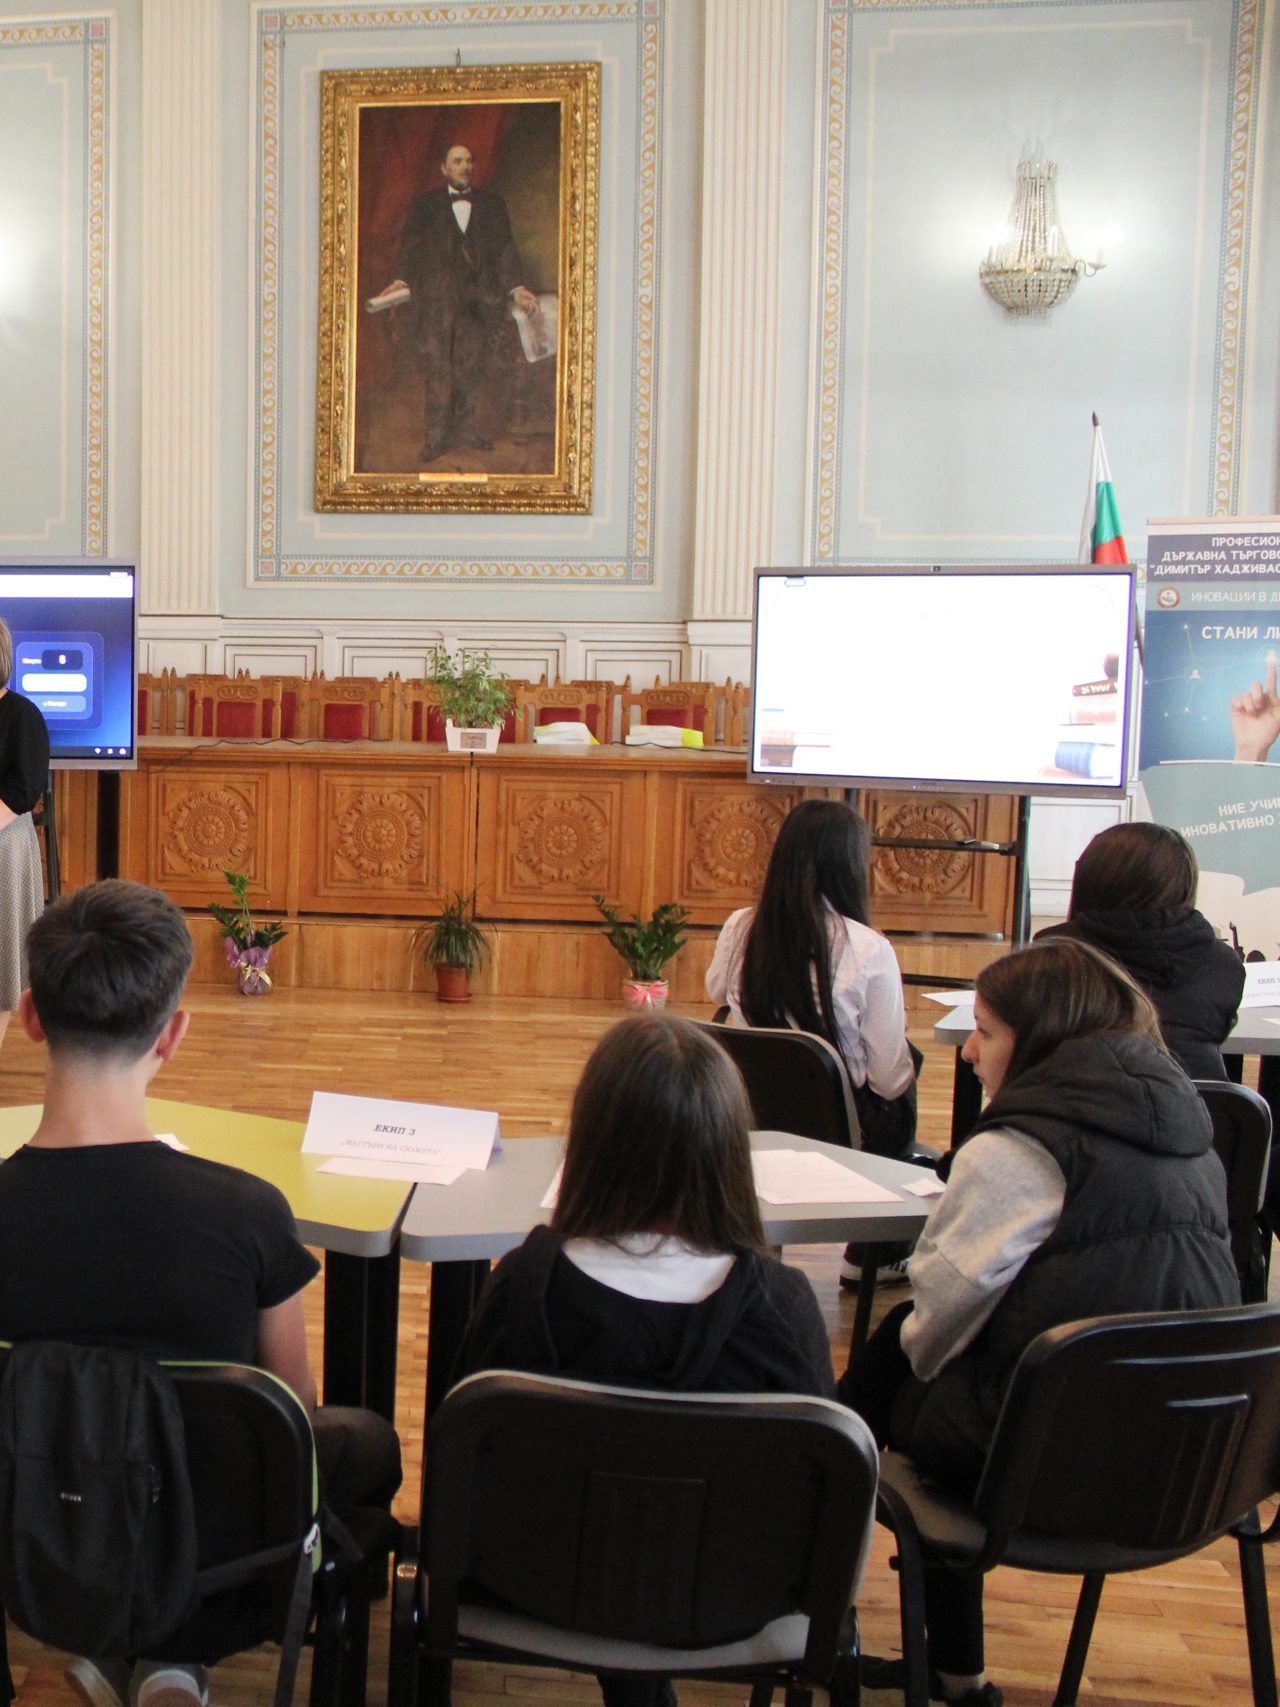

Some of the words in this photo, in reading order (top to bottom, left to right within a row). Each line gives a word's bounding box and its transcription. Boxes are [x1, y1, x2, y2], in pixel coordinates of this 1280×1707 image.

[1161, 550, 1227, 562] ДЪРЖАВНА
[1191, 591, 1256, 603] ИНОВАЦИИ
[1258, 591, 1266, 602] В
[1201, 626, 1258, 640] СТАНИ
[1218, 802, 1247, 817] НИЕ
[1181, 814, 1275, 837] ИНОВАТИВНО
[374, 1124, 406, 1135] ЕКИП
[408, 1128, 416, 1136] 3
